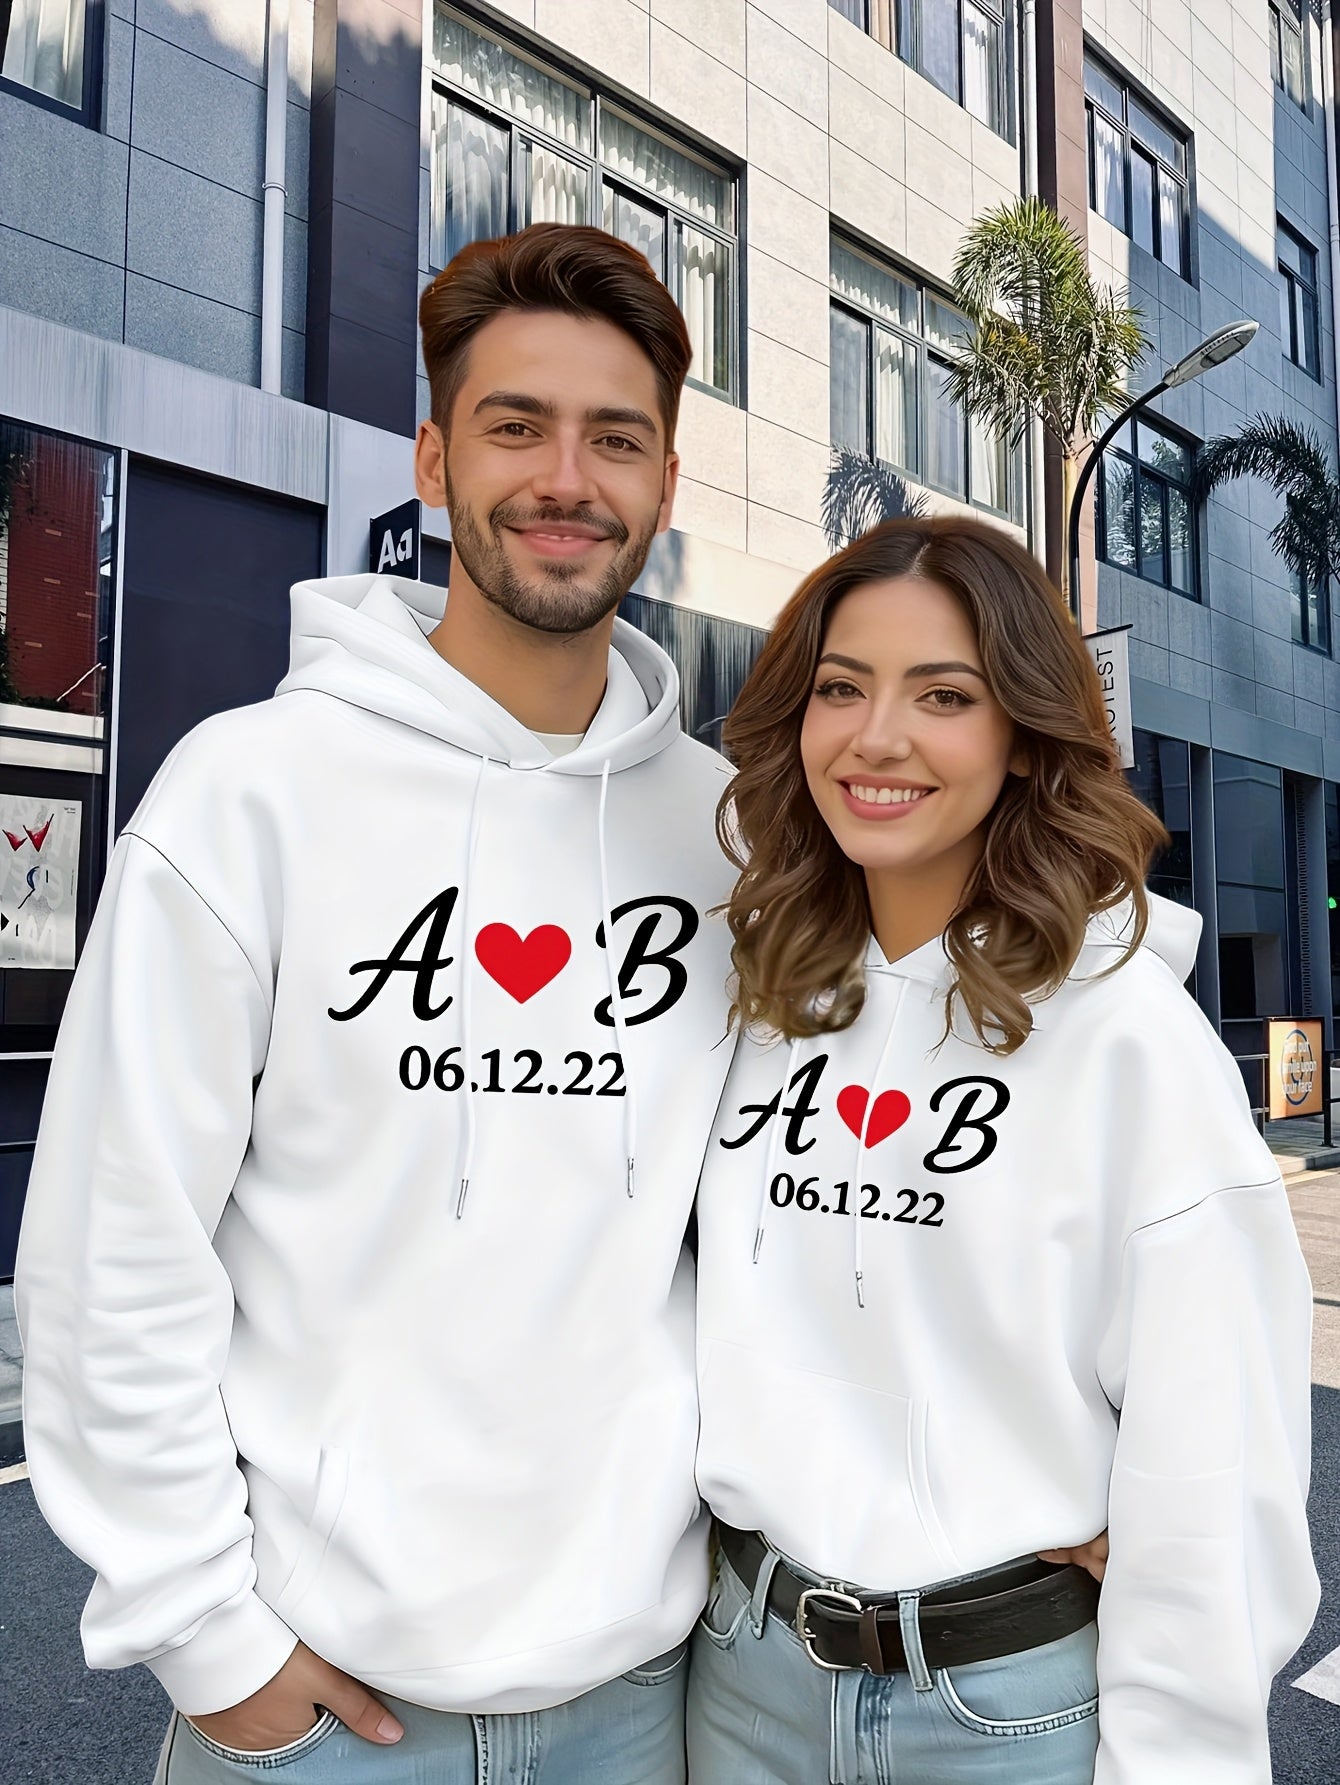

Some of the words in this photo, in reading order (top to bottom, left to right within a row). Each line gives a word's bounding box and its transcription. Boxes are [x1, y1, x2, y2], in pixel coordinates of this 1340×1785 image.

[377, 527, 412, 573] Aa
[328, 887, 459, 1021] A
[594, 896, 699, 1027] B
[400, 1046, 627, 1097] 06.12.22
[720, 1054, 829, 1155] A
[923, 1076, 1011, 1174] B
[770, 1173, 945, 1228] 06.12.22
